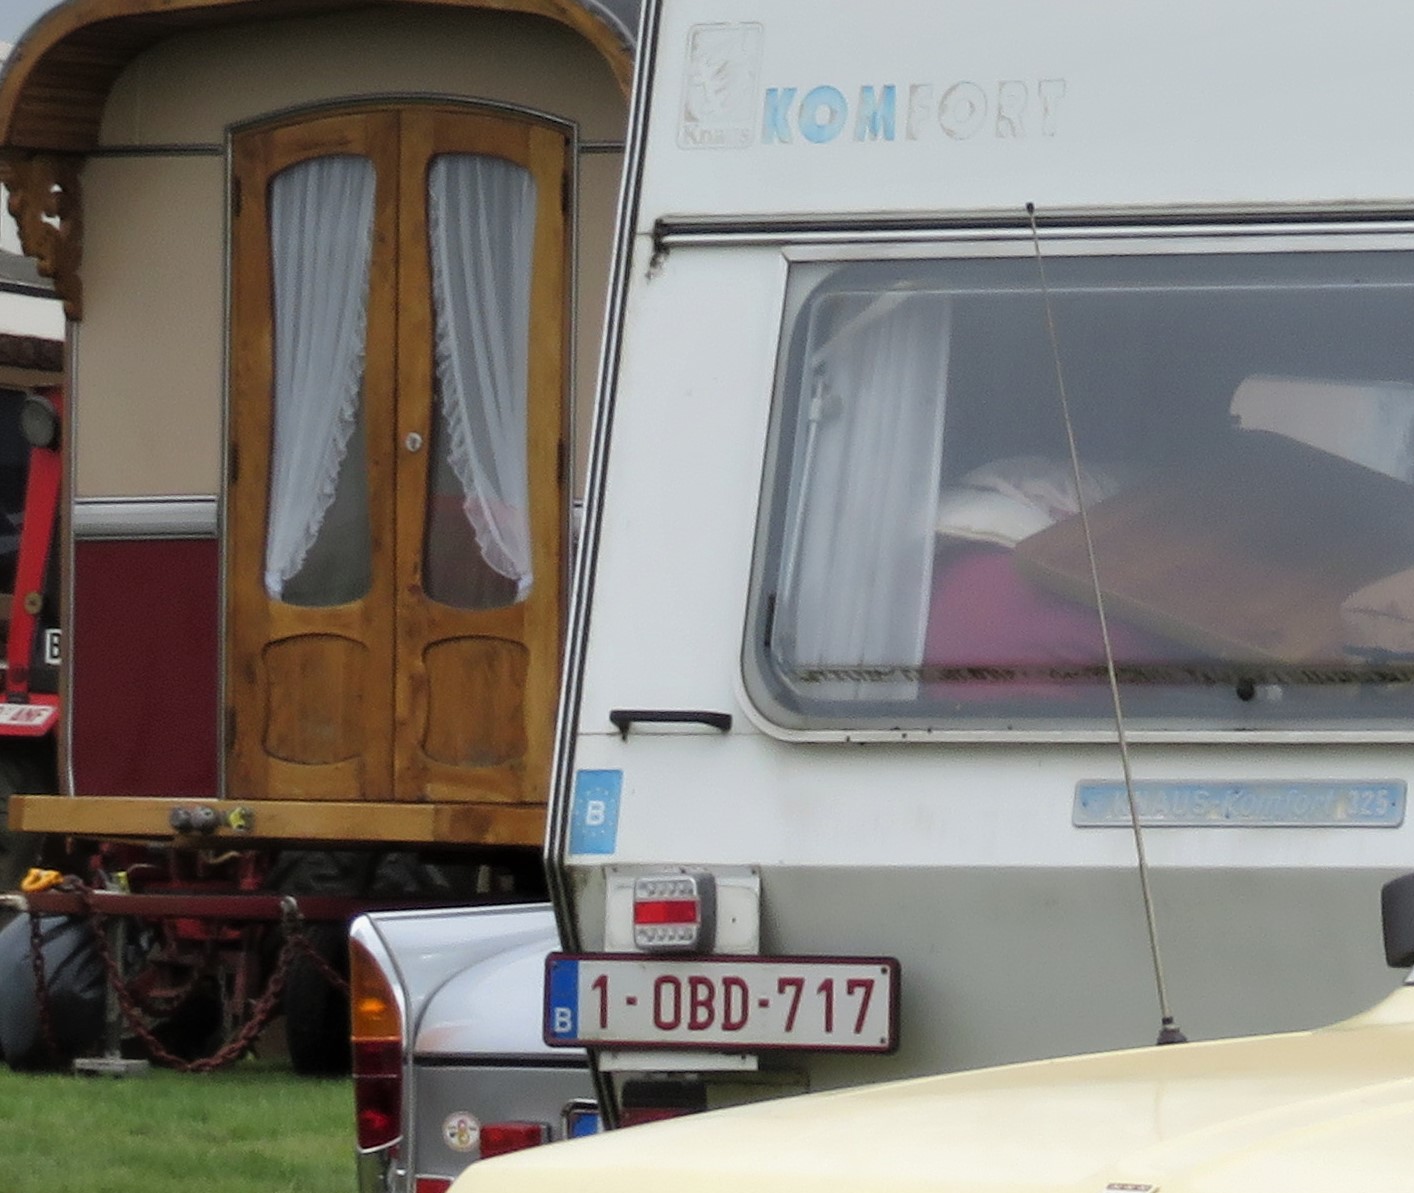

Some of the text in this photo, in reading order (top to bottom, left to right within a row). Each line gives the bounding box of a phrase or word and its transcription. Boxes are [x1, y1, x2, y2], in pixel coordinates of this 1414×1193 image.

[761, 78, 1067, 145] KOMFORT
[586, 800, 605, 826] B
[554, 1007, 573, 1033] B
[591, 974, 876, 1034] 1-OBD-717
